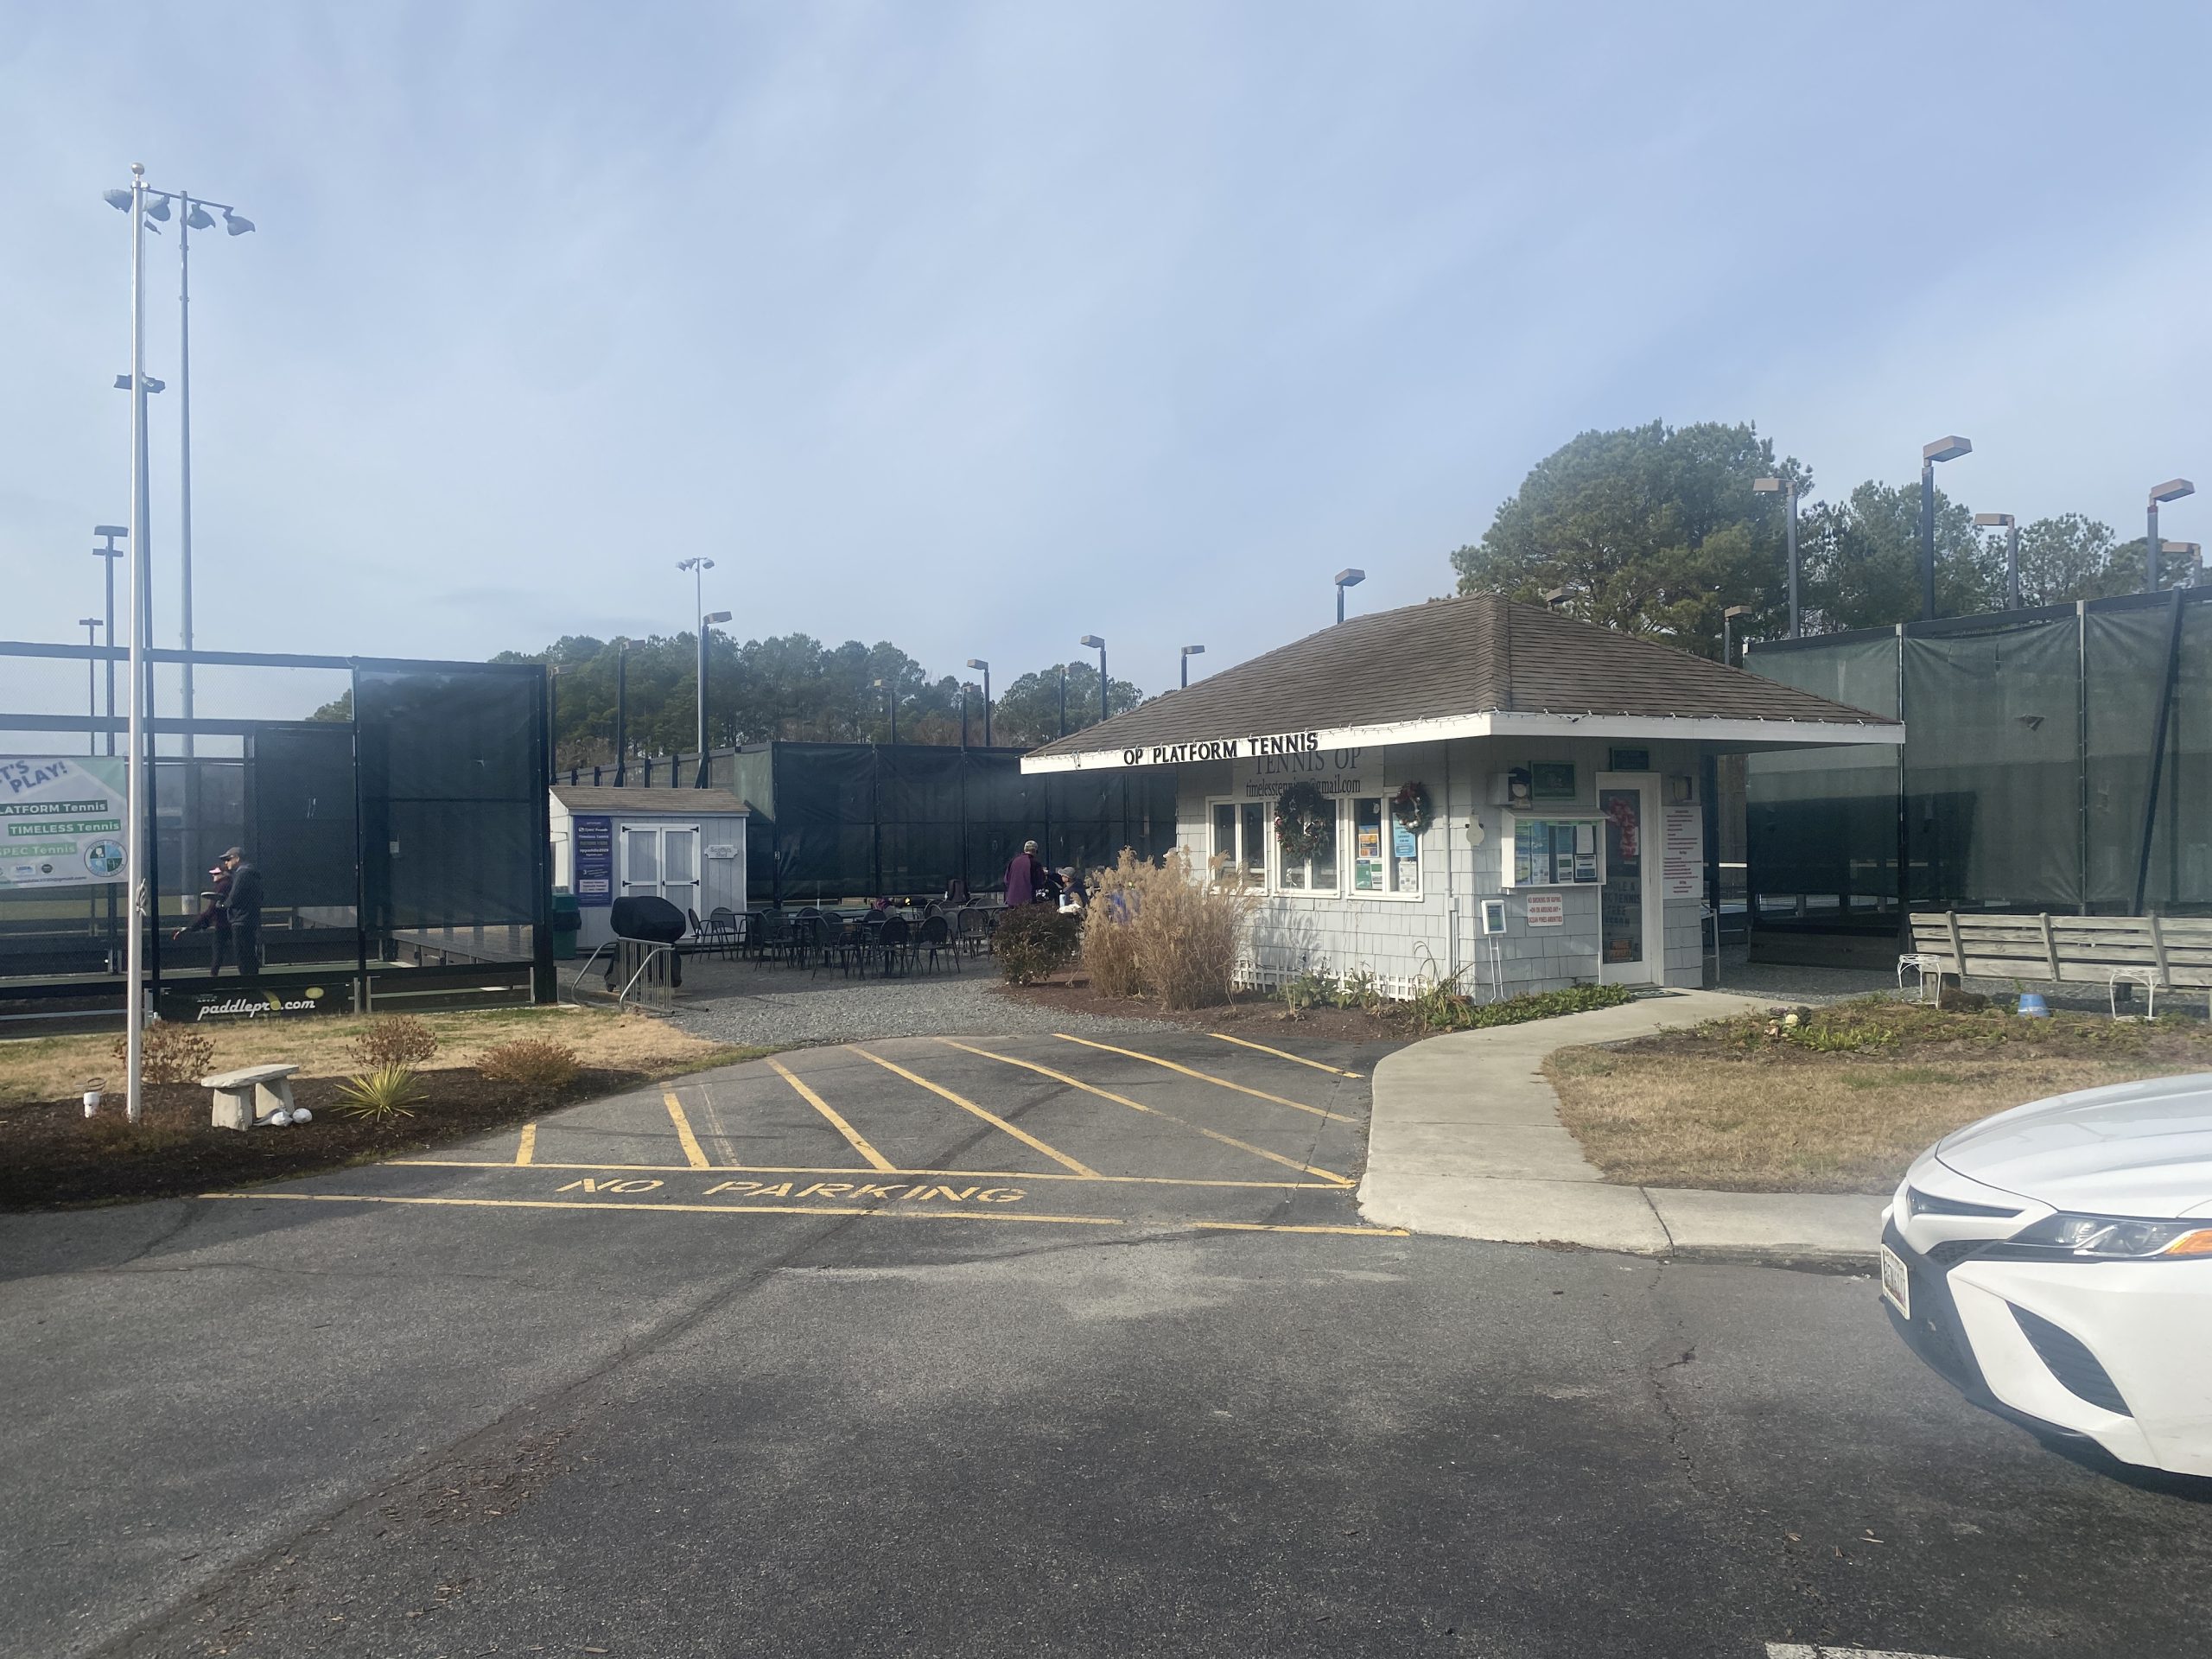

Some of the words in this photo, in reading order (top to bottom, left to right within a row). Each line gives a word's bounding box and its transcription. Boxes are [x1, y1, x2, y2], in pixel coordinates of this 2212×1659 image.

[1123, 748, 1143, 765] OP
[1153, 740, 1238, 764] PLATFORM
[1248, 732, 1319, 756] TENNIS
[0, 760, 29, 782] T'S
[1256, 750, 1325, 775] TENNIS
[1334, 747, 1361, 770] OP
[10, 760, 67, 793] PLAY!
[63, 801, 106, 813] Tennis
[10, 823, 74, 836] TIMELESS
[77, 822, 120, 832] Tennis
[33, 844, 76, 855] Tennis
[554, 1178, 664, 1193] NO
[702, 1180, 1028, 1203] PARKING
